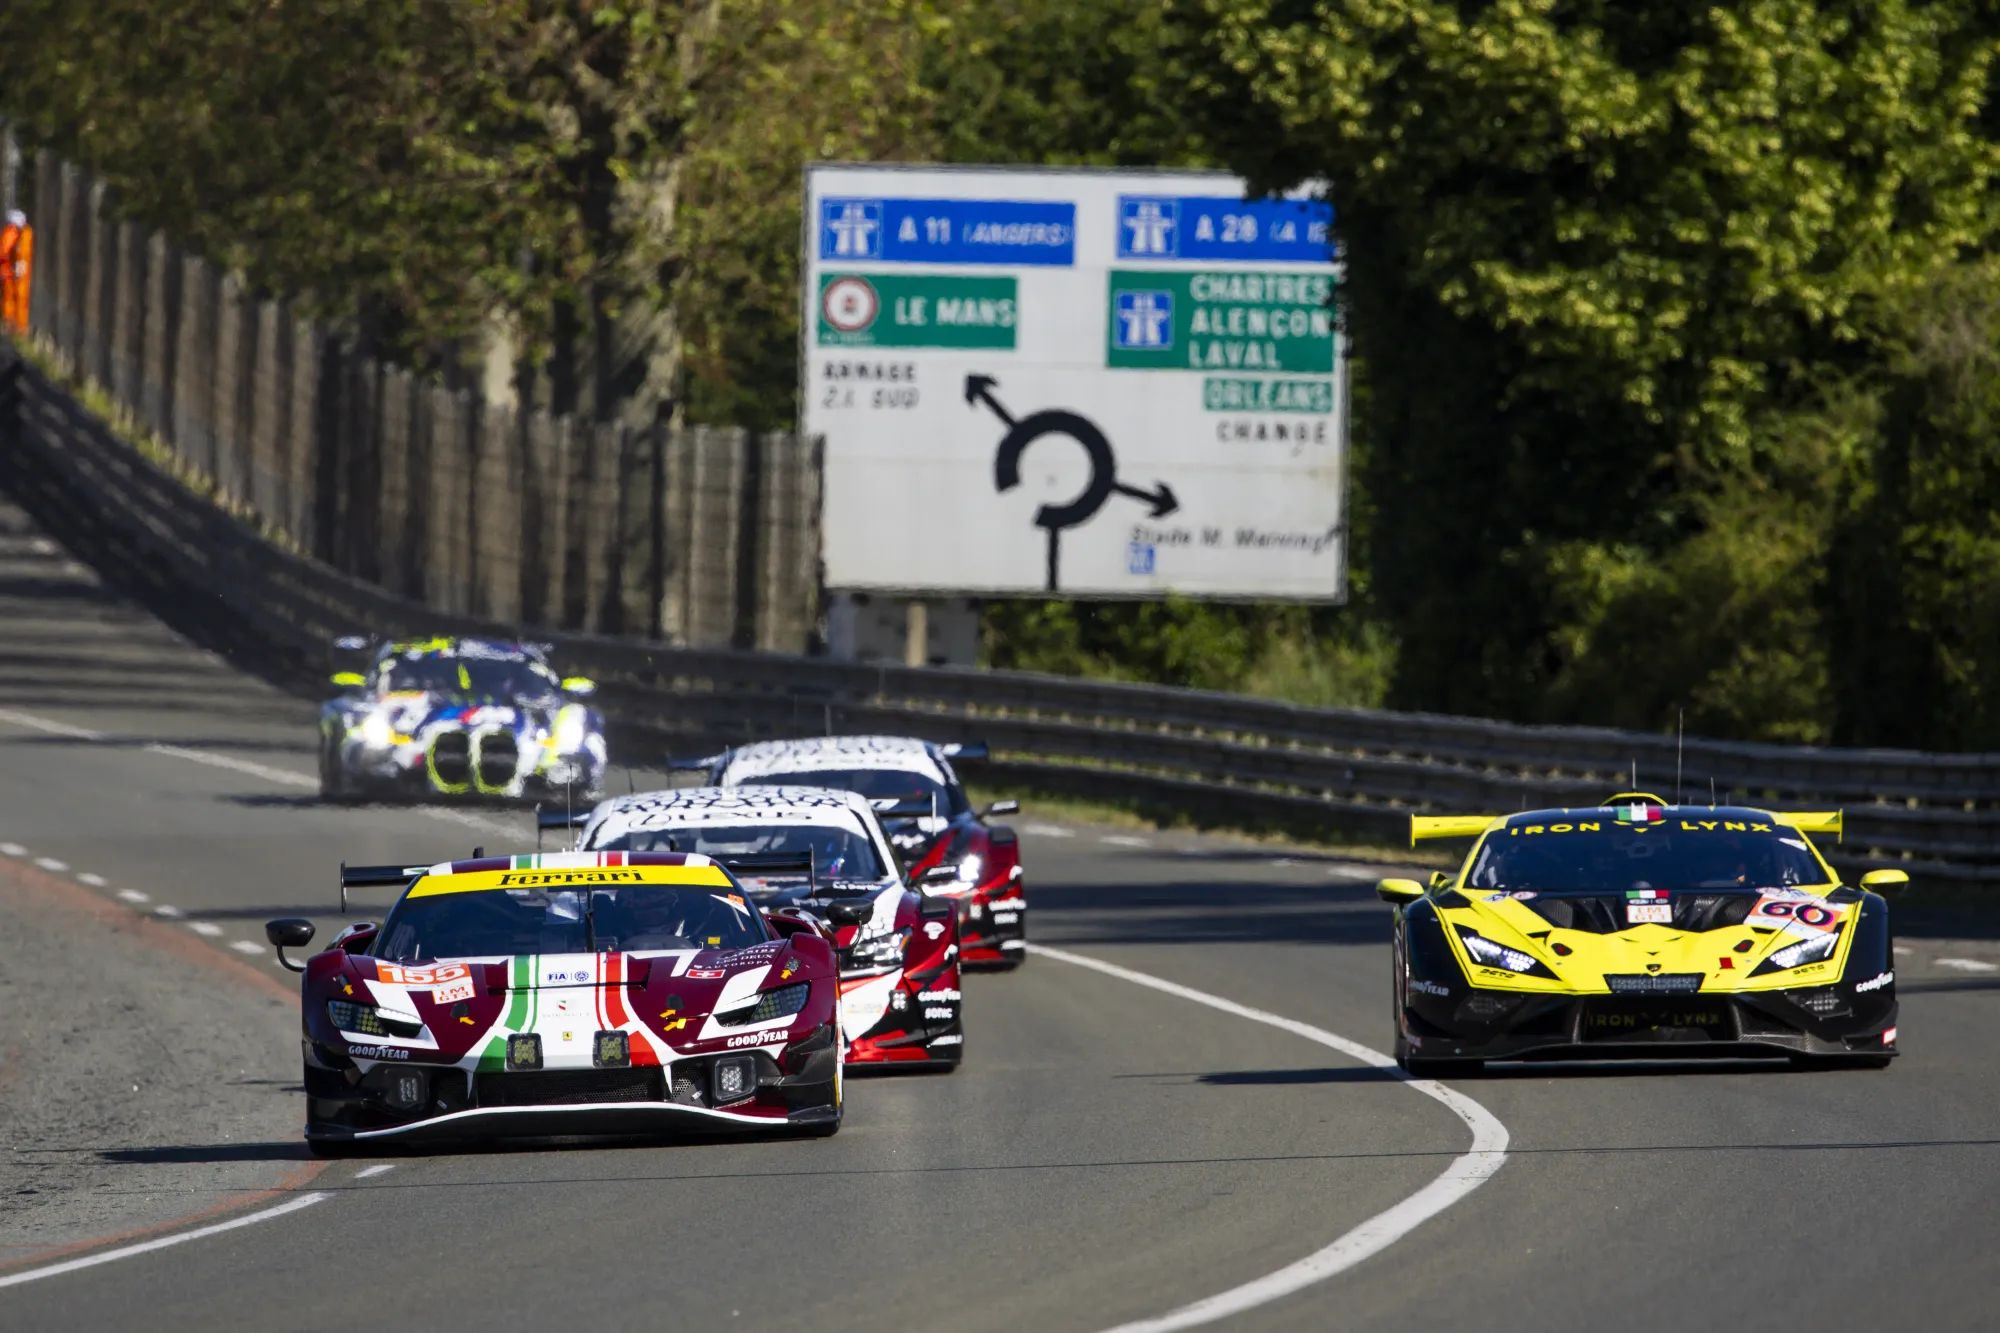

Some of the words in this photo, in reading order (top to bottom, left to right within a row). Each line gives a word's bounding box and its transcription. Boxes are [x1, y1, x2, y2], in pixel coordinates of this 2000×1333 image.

[898, 216, 918, 242] A
[925, 216, 950, 244] 11
[1195, 214, 1214, 242] A
[1189, 274, 1331, 304] CHARTRES
[895, 297, 927, 326] LE
[936, 297, 1015, 328] MANS
[1189, 340, 1281, 369] LAVAL
[1510, 822, 1600, 836] IRON
[1681, 821, 1773, 833] LYNX
[496, 869, 645, 886] Ferrari
[1758, 901, 1834, 926] 60
[381, 963, 466, 984] 155
[548, 973, 567, 981] FIA
[1589, 1014, 1636, 1028] IRON
[1673, 1012, 1721, 1026] LYNX
[727, 1029, 788, 1047] GOODYEAR
[348, 1045, 409, 1060] GOODYEAR
